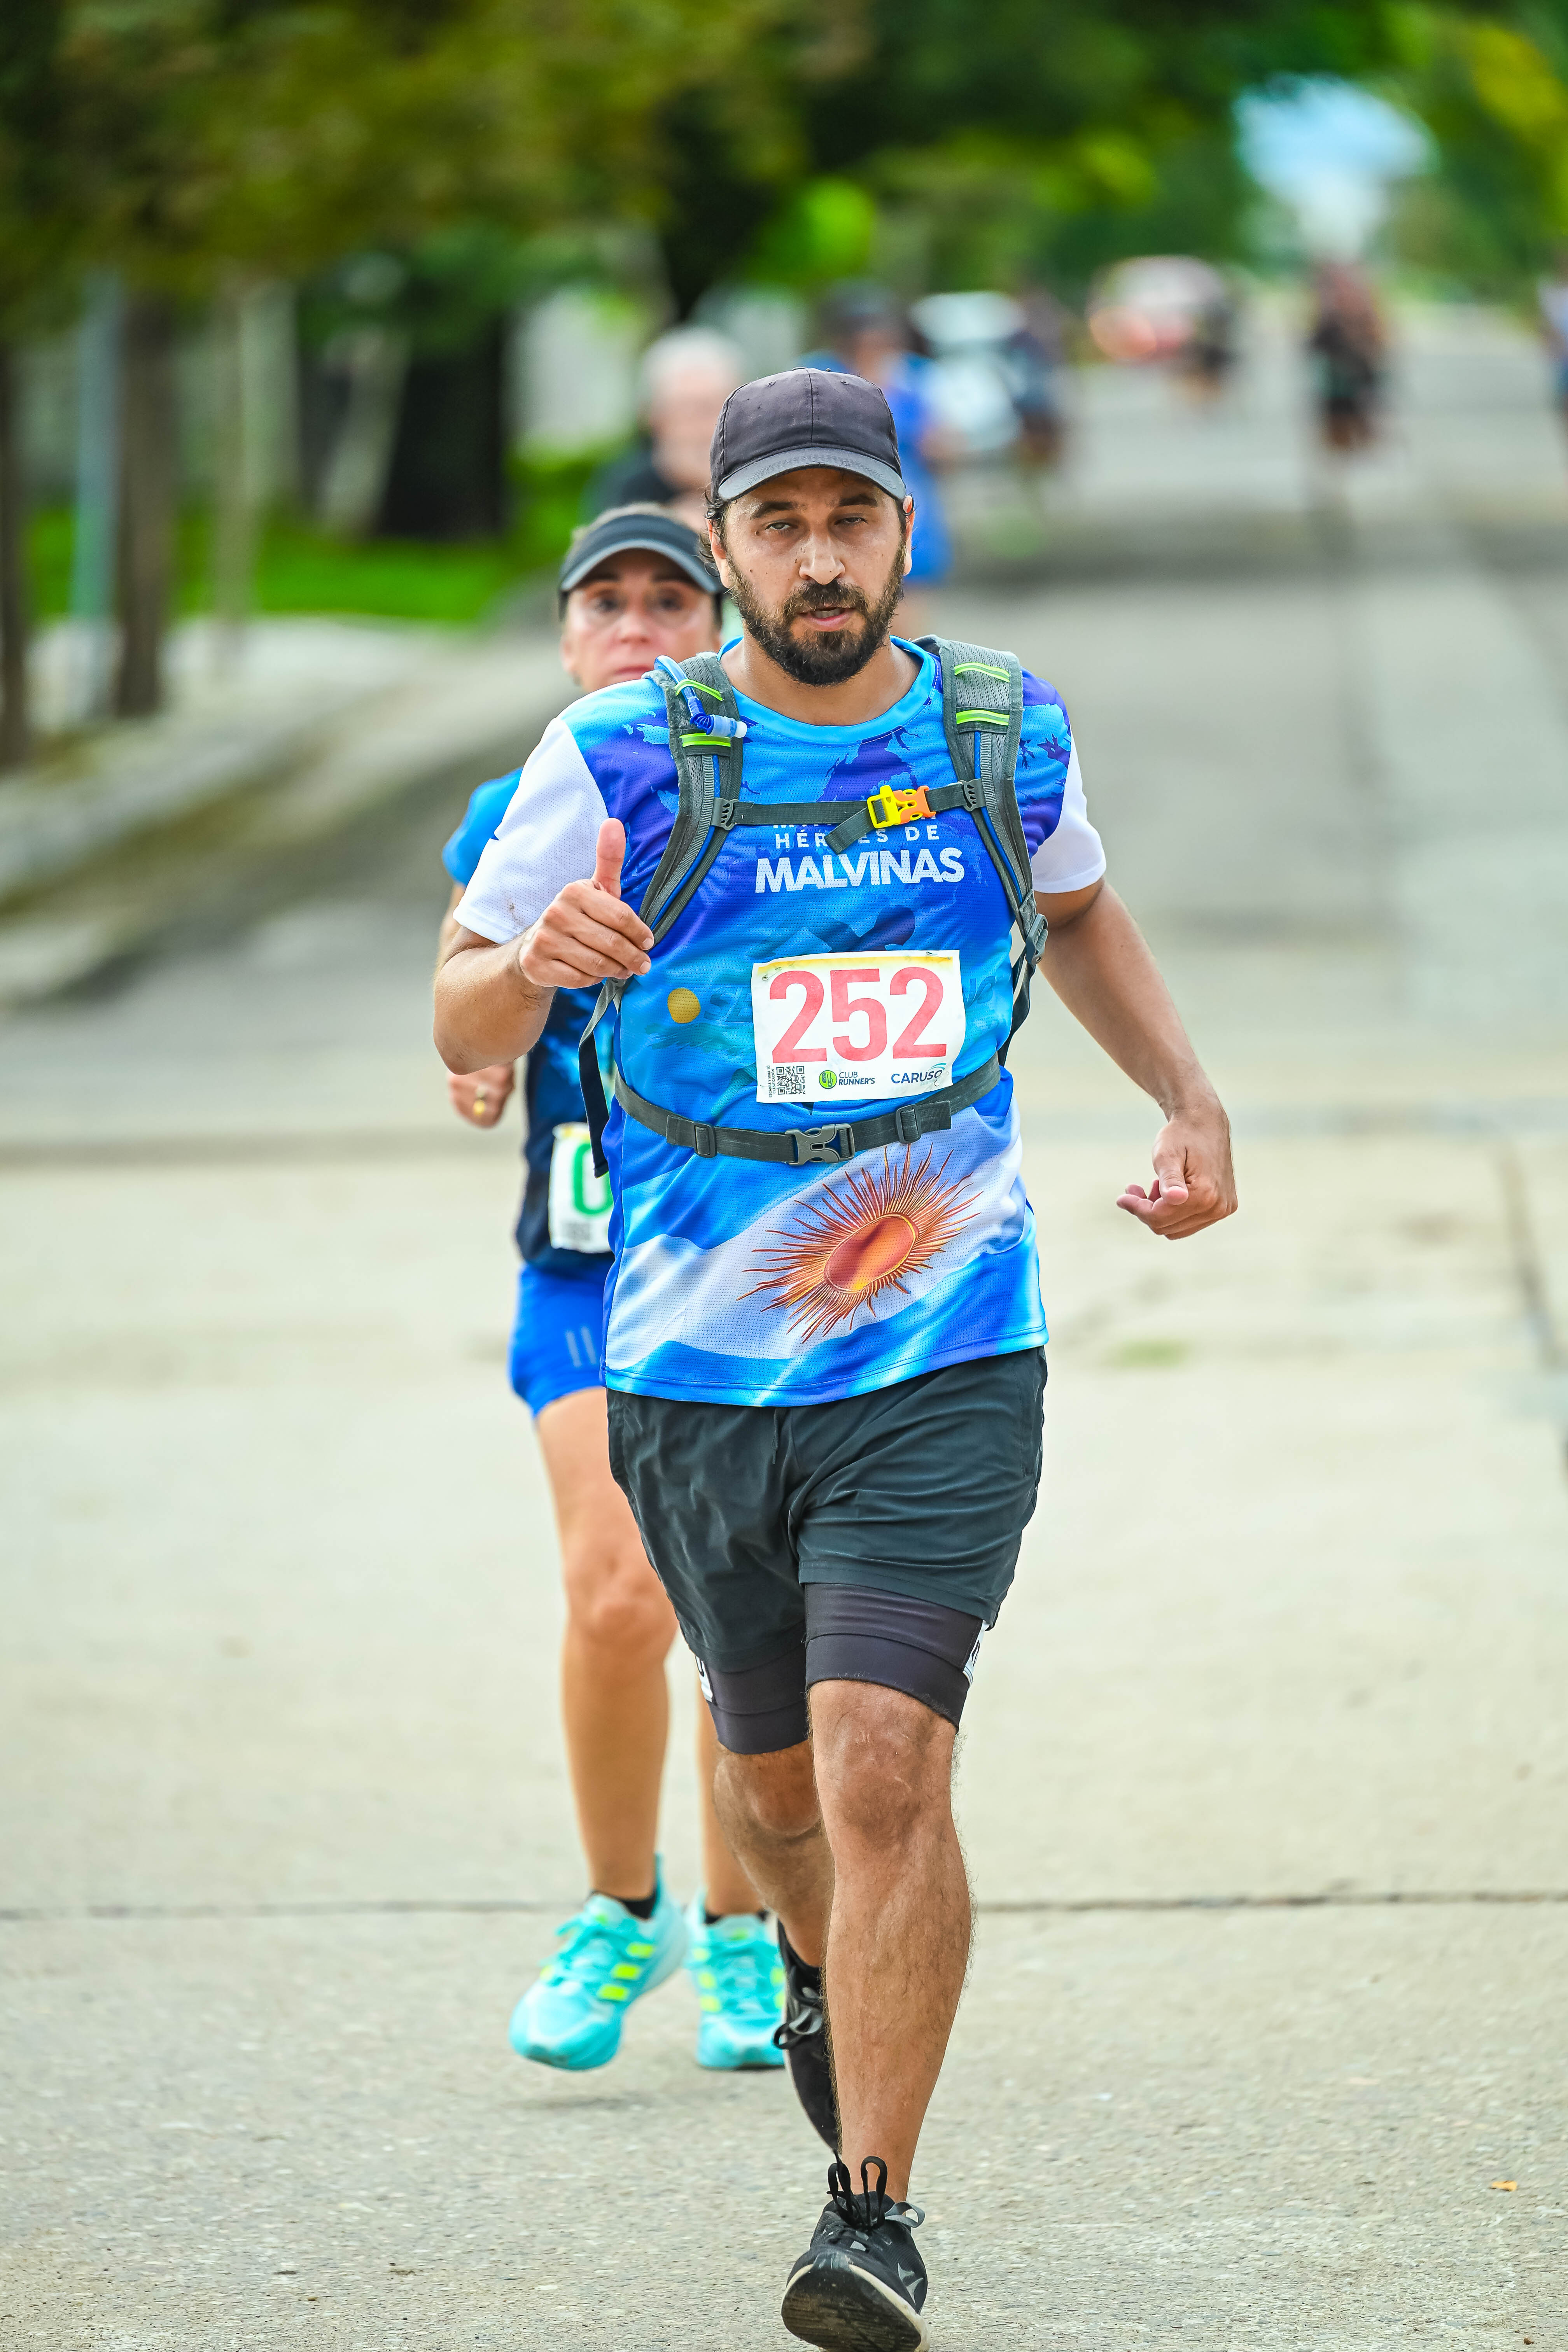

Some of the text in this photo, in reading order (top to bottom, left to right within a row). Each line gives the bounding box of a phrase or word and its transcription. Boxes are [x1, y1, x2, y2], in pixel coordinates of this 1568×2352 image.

[775, 824, 940, 849] HÉRES DE
[755, 847, 965, 893] MALVINAS
[770, 967, 947, 1063] 252
[891, 1070, 943, 1083] CARUSO
